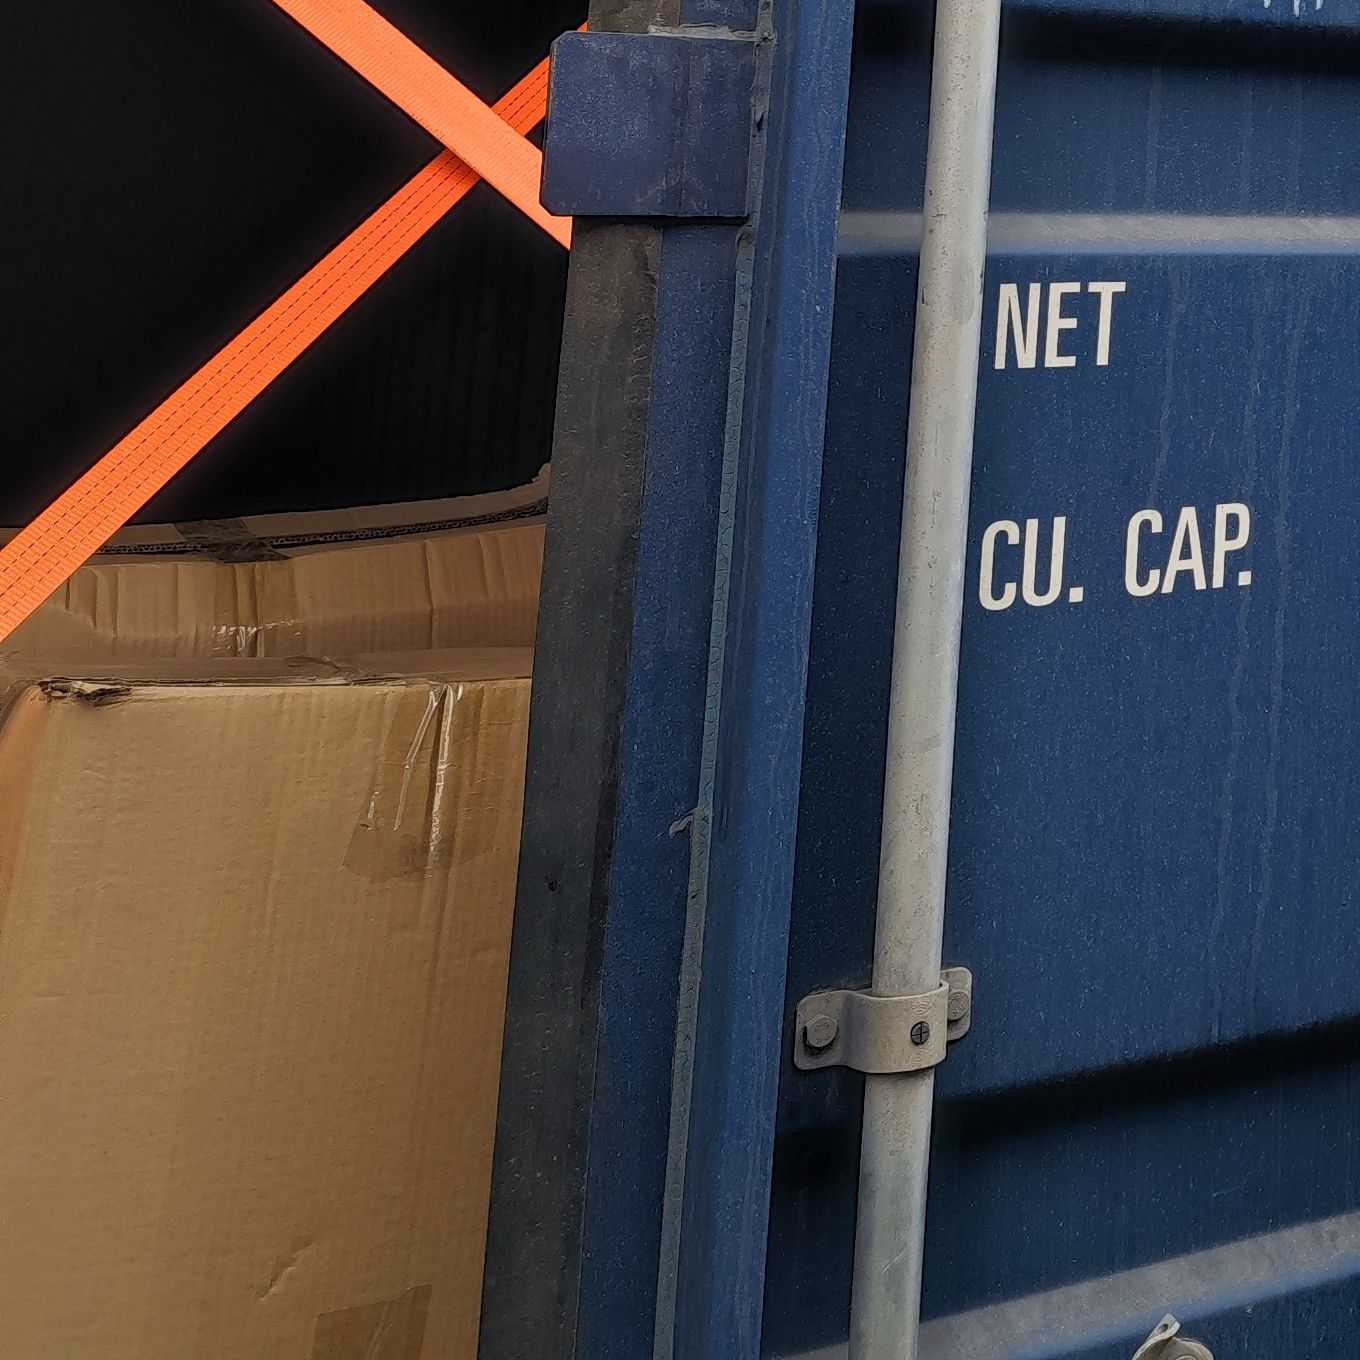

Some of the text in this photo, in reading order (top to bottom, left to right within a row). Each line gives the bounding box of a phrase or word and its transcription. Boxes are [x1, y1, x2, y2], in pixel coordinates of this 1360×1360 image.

[993, 281, 1127, 370] NET
[978, 515, 1085, 612] CU.
[1124, 502, 1253, 598] CAP.
